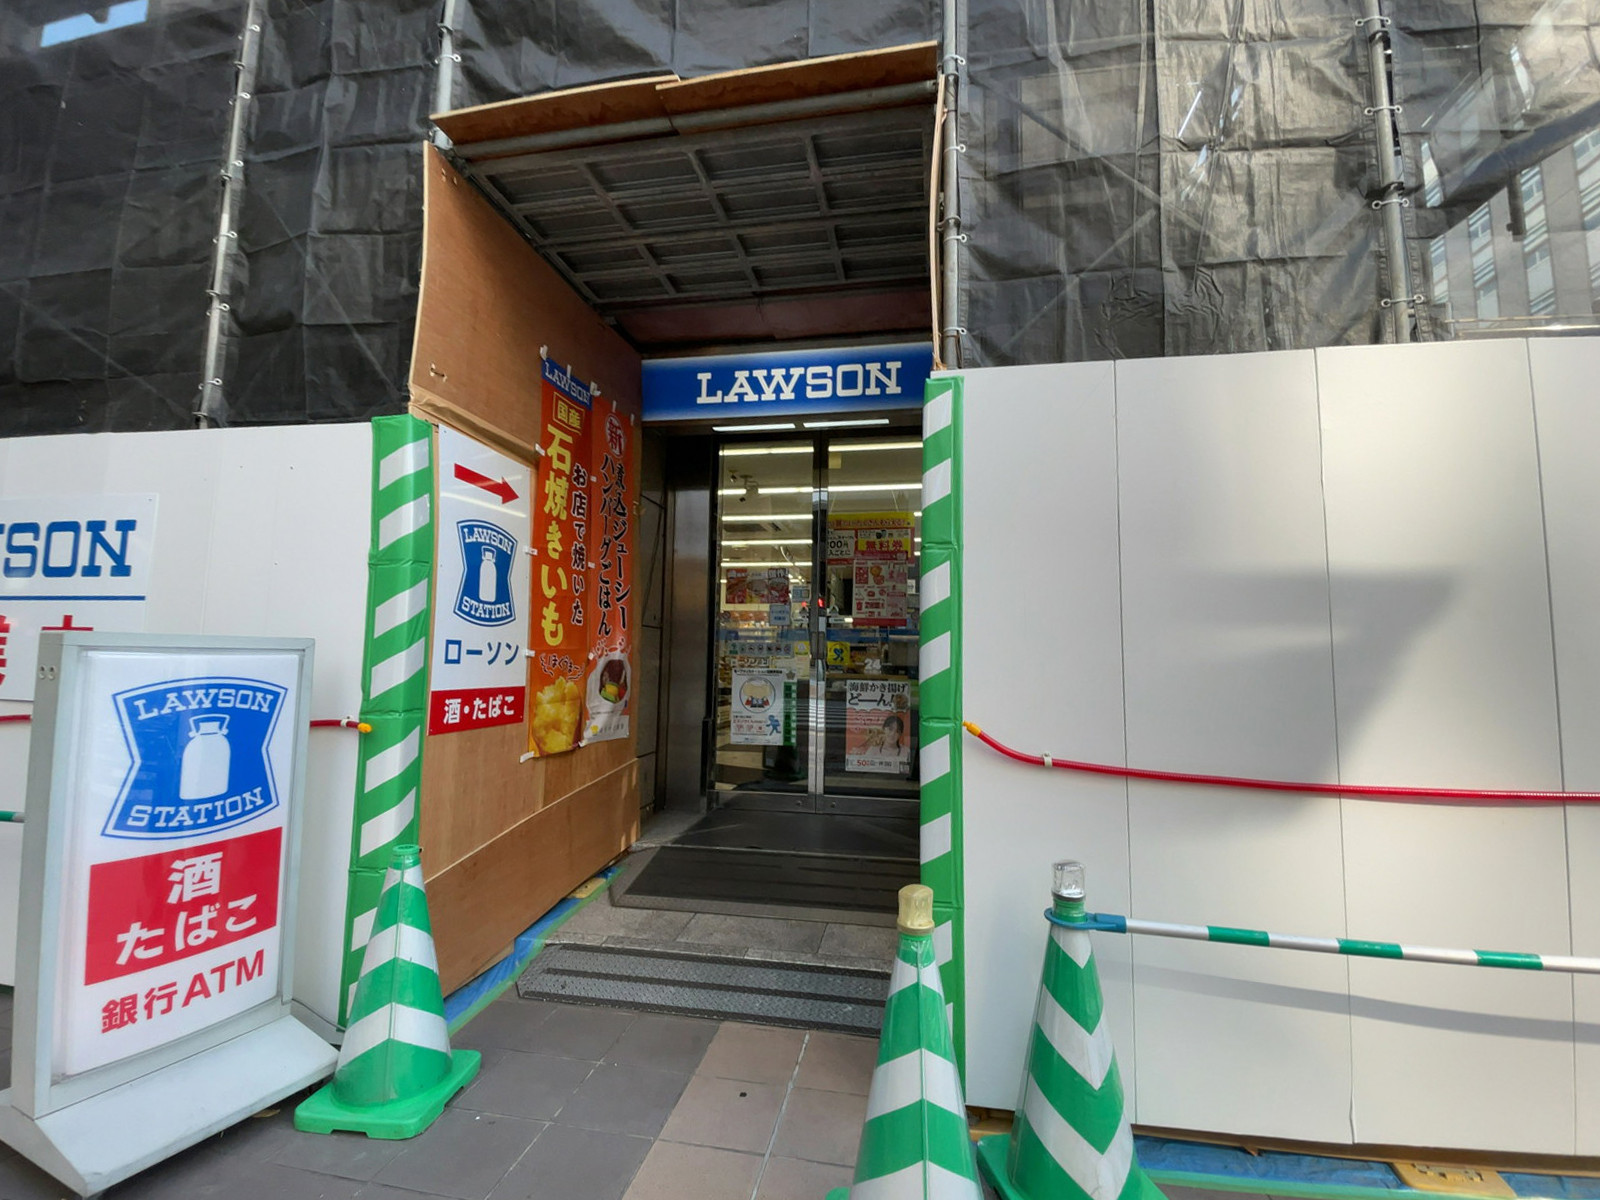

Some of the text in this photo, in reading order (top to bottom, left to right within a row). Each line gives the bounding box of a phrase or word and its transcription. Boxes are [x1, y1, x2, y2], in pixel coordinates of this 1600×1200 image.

[544, 362, 590, 405] LAWSON
[696, 361, 902, 404] LAWSON
[557, 401, 581, 429] 国産
[606, 418, 624, 456] 新
[0, 518, 137, 577] SON
[463, 527, 513, 555] LAWSON
[541, 423, 573, 646] 石焼きいも
[571, 463, 587, 626] お店で焼いた
[598, 453, 616, 637] ハンバーグごはん
[461, 595, 511, 619] STATION
[444, 639, 519, 665] ローソン
[133, 688, 275, 721] LAWSON
[849, 682, 908, 693] 海鮮かき揚げ
[443, 695, 515, 724] 酒・たばこ
[126, 787, 265, 828] STATION
[166, 851, 223, 904] 酒
[116, 893, 259, 965] たばこ
[101, 949, 265, 1034] 銀行ATM
